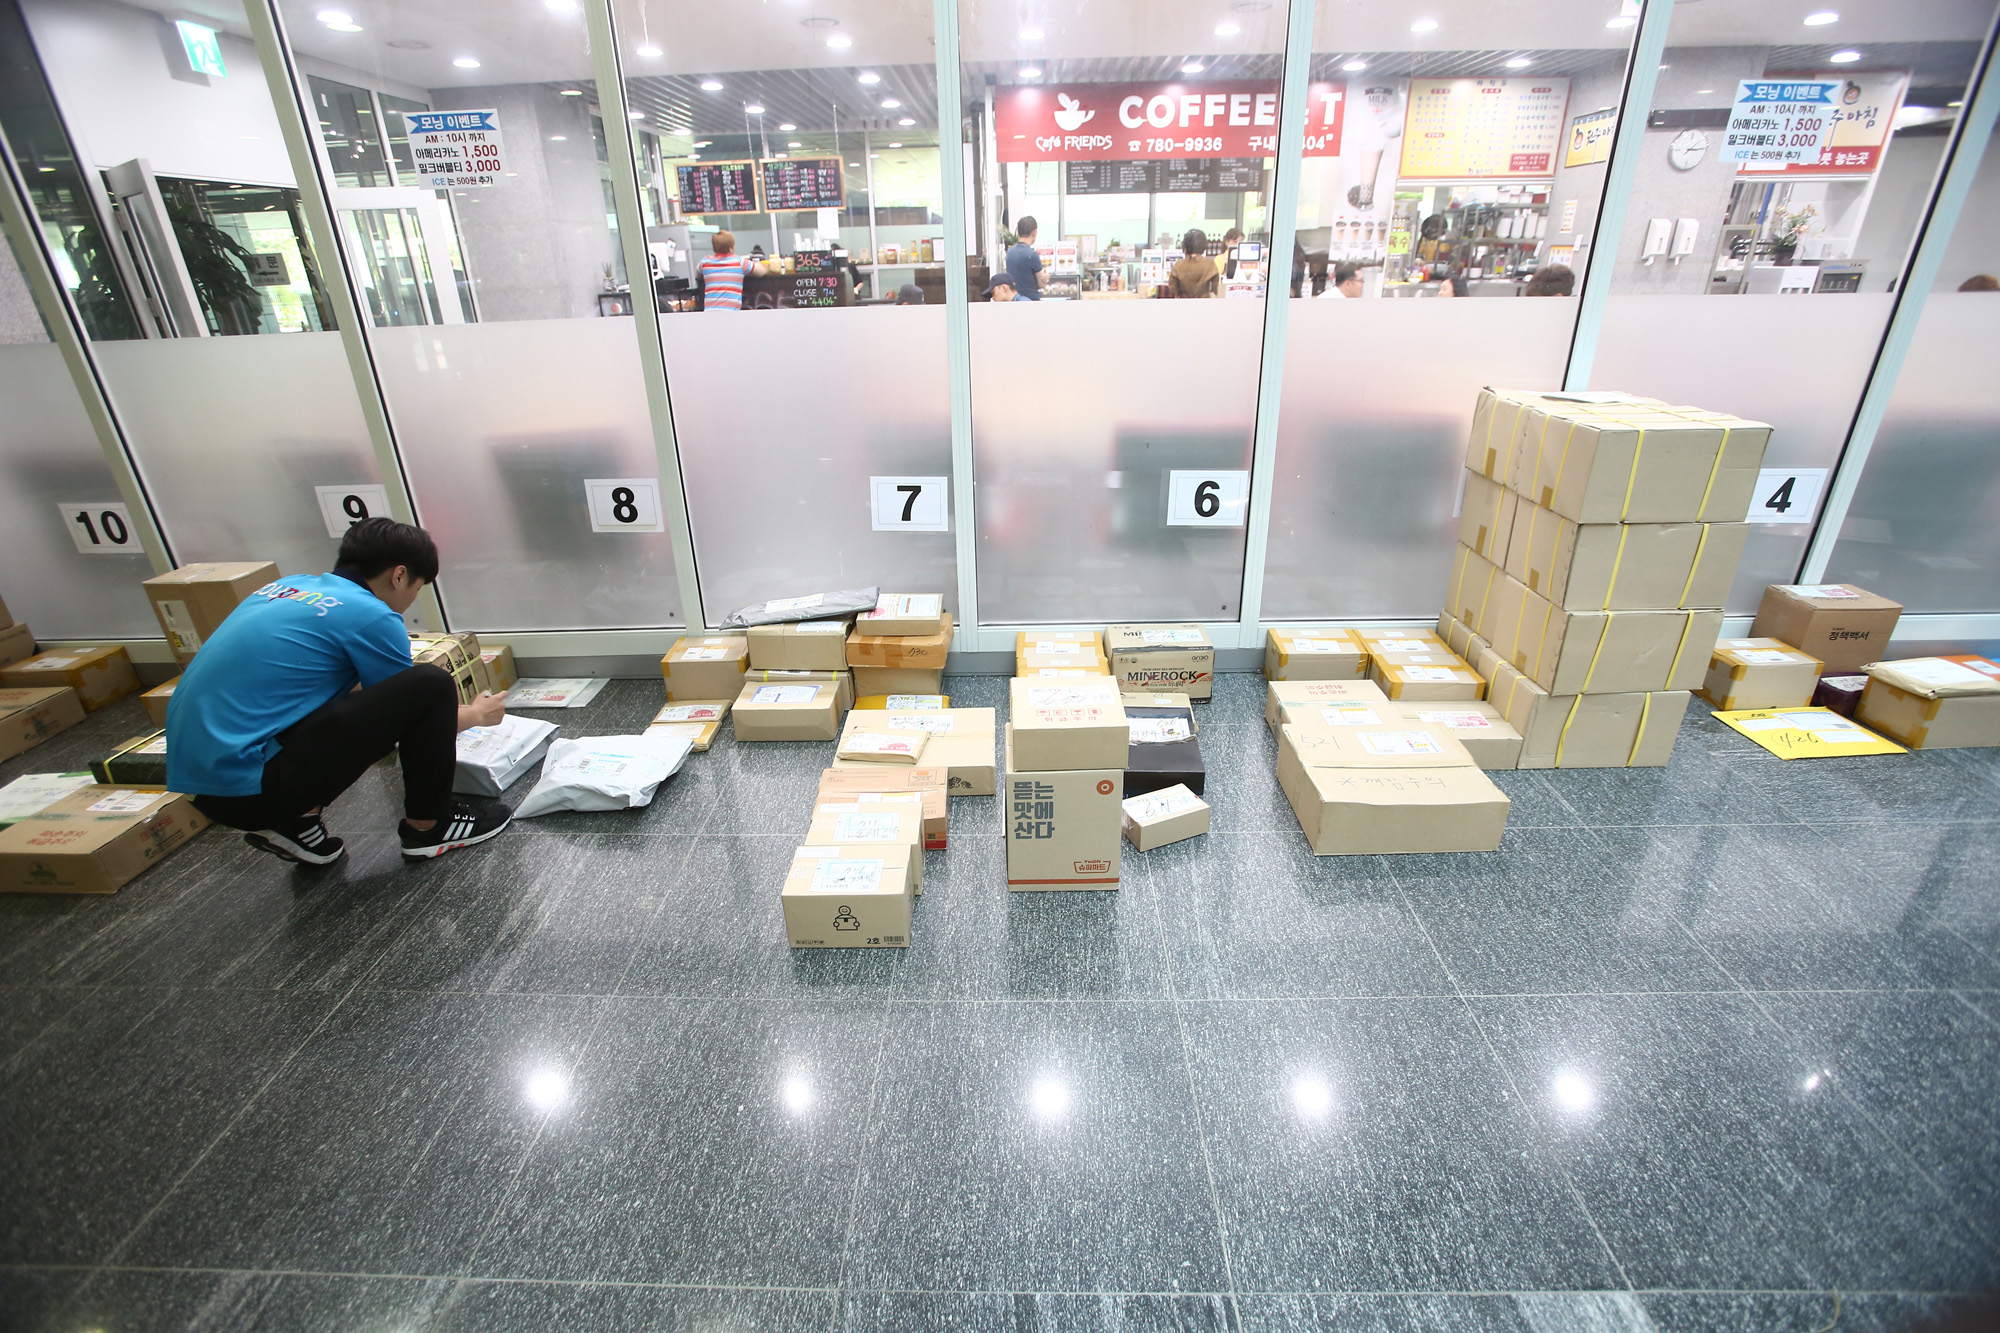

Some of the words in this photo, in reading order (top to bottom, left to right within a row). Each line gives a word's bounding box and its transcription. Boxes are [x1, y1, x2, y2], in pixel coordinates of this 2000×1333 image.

[1754, 84, 1780, 99] 모닝
[1784, 84, 1821, 99] 이벤트
[1118, 93, 1276, 128] COFFEE
[1750, 106, 1764, 114] AM
[1774, 104, 1795, 114] 10시
[1797, 104, 1817, 115] 까지
[421, 116, 444, 130] 모닝
[447, 114, 483, 129] 이벤트
[1732, 118, 1779, 130] 아메리카노
[1784, 118, 1822, 132] 1,500
[425, 135, 439, 143] AM
[446, 132, 467, 143] 10시
[469, 132, 486, 143] 까지
[1035, 136, 1061, 152] Café
[1064, 135, 1113, 150] FRIENDS
[1146, 137, 1222, 152] 780-9936
[1248, 136, 1276, 151] 구내
[1727, 134, 1775, 147] 밀크버블티
[1777, 133, 1817, 148] 3,000
[415, 147, 460, 159] 아메리카노
[462, 144, 498, 159] 1,500
[1734, 151, 1749, 159] ICE
[1750, 151, 1760, 160] 는
[1761, 150, 1783, 160] 500원
[1784, 150, 1801, 160] 추가
[1835, 151, 1870, 166] 놓는곳
[418, 162, 463, 175] 밀크버블티
[465, 159, 501, 173] 3,000
[432, 177, 446, 186] ICE
[447, 177, 455, 186] 는
[456, 176, 478, 185] 500원
[479, 175, 494, 185] 추가
[796, 253, 821, 267] 365
[796, 277, 817, 287] OPEN
[793, 288, 817, 297] CLOSE
[1194, 480, 1221, 518] 6
[1765, 476, 1796, 514] 4
[342, 494, 370, 526] 9
[611, 486, 639, 524] 8
[896, 485, 923, 522] 7
[75, 510, 129, 545] 10
[252, 582, 343, 617] oupang
[1829, 631, 1870, 641] 정책백서
[1127, 670, 1198, 681] MINEROCK
[1300, 734, 1341, 750] 521
[1013, 781, 1054, 799] 뜯는
[1014, 801, 1053, 820] 맛에
[1014, 821, 1055, 839] 산다
